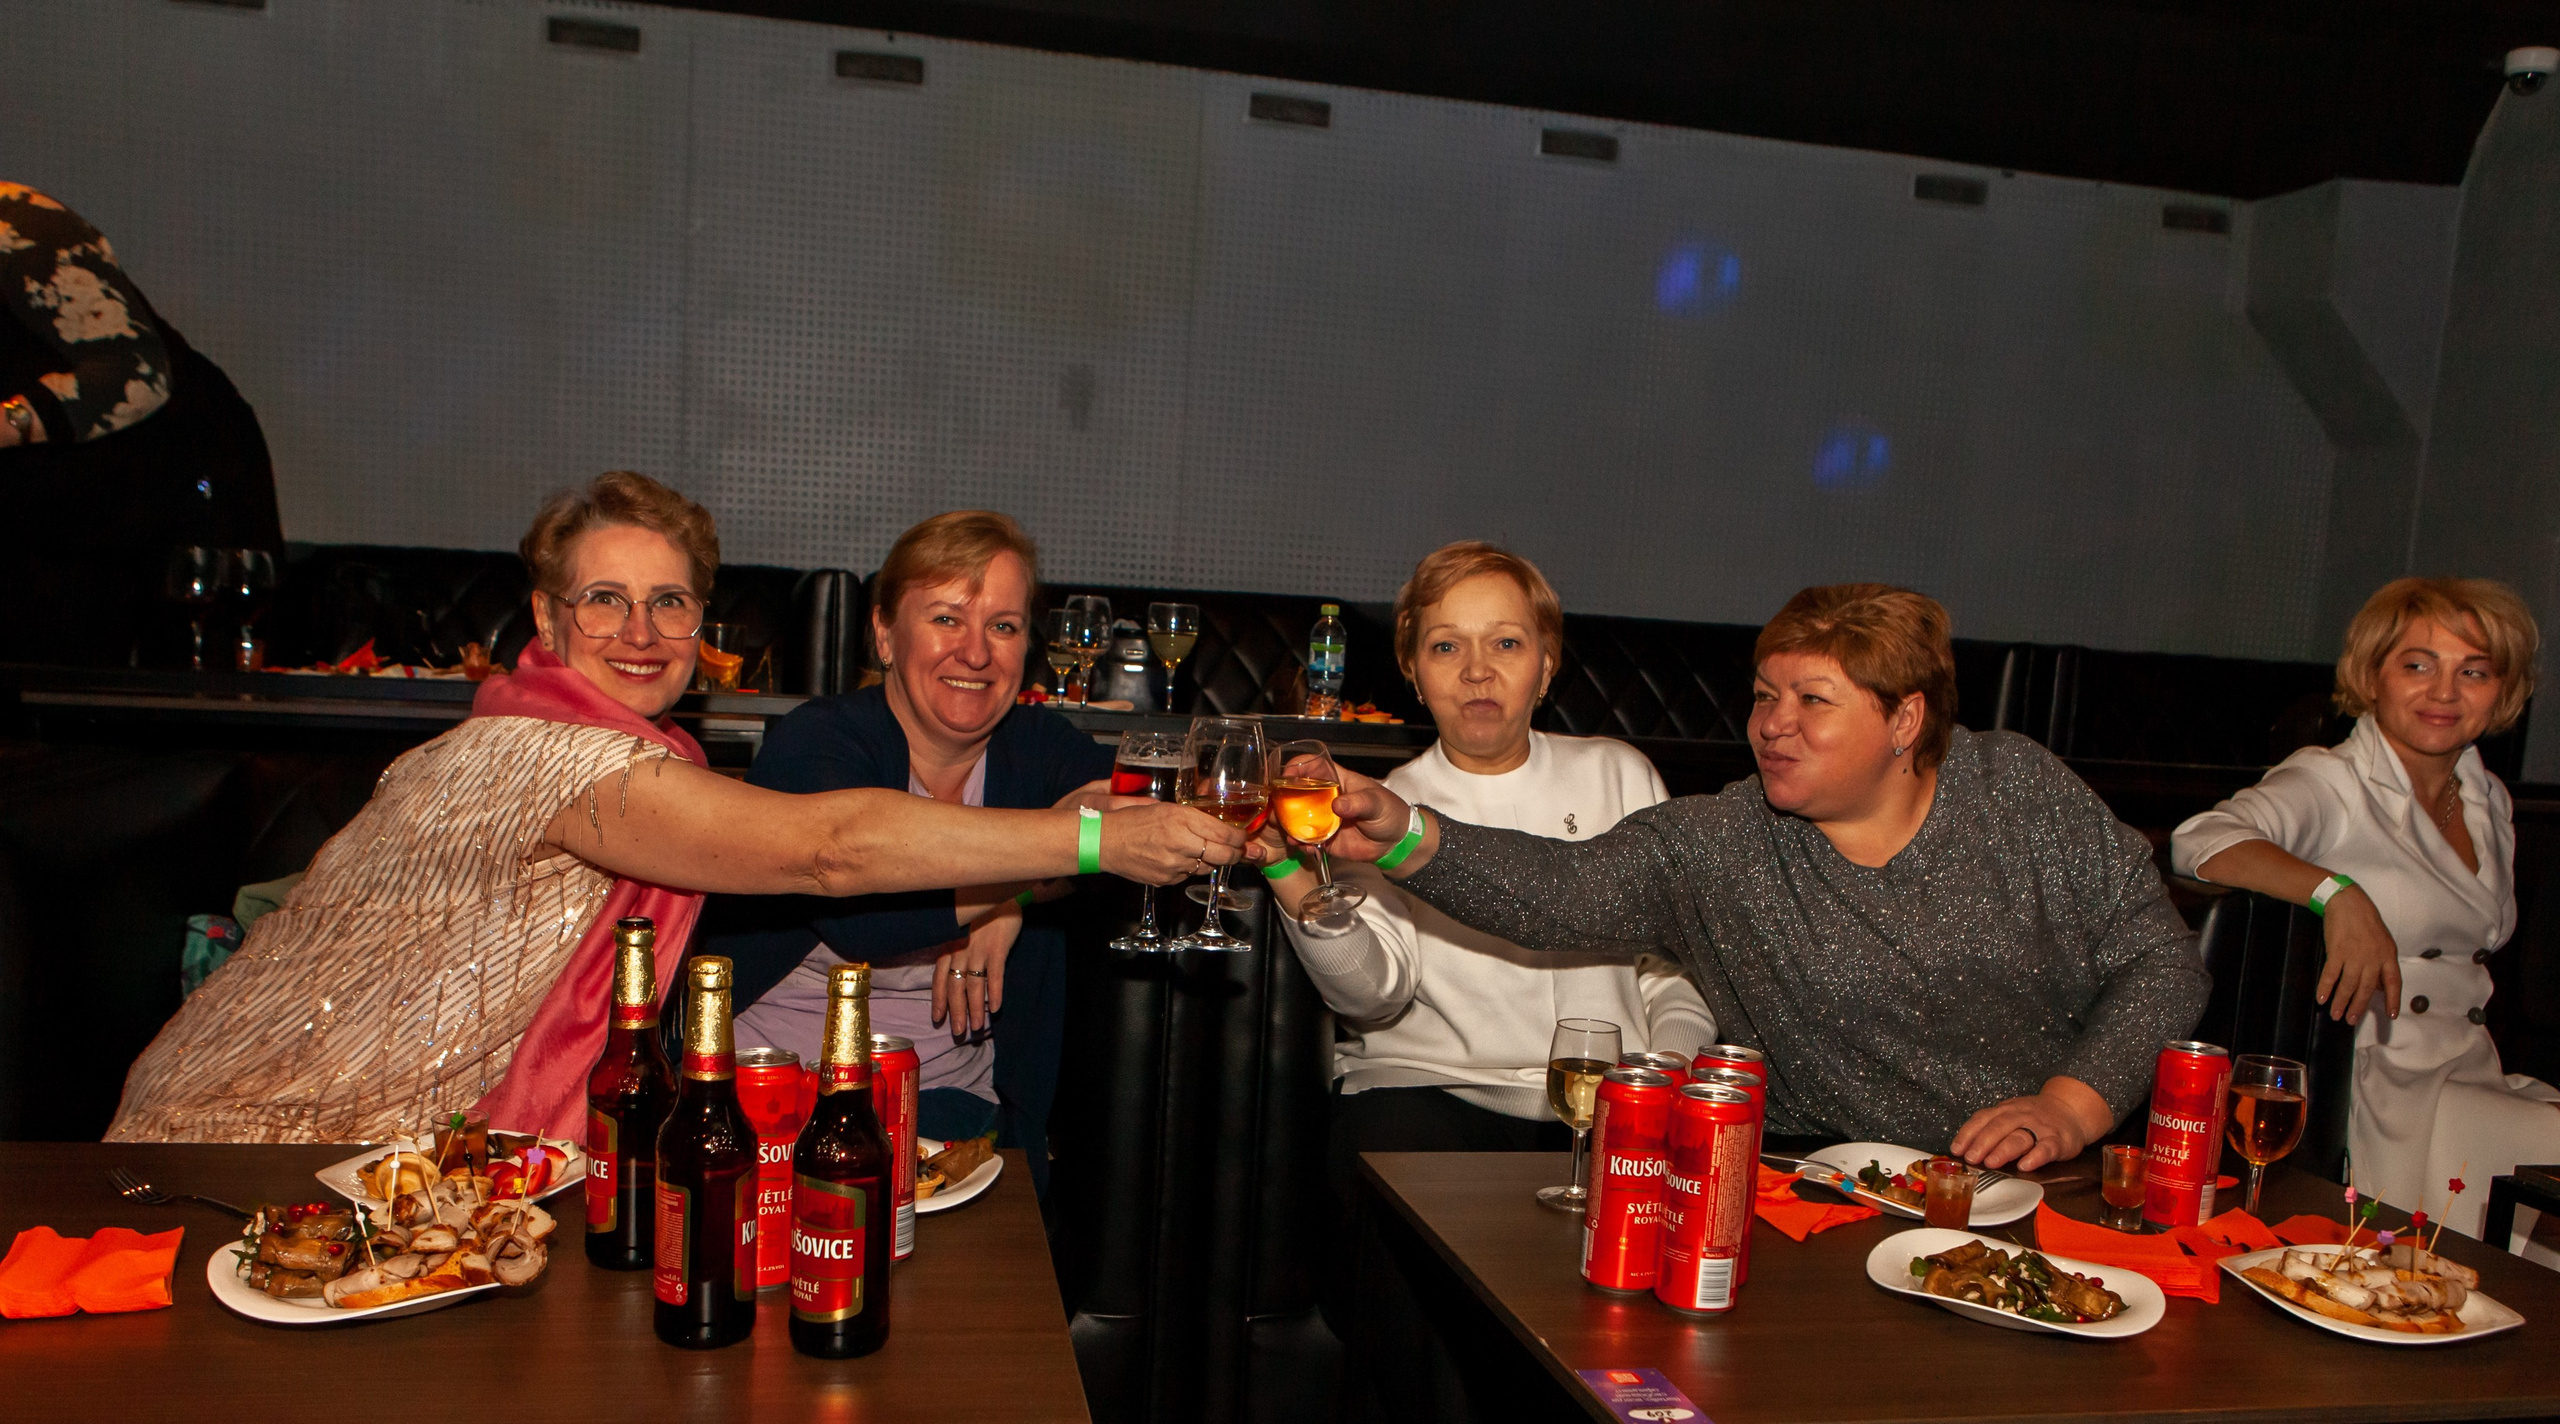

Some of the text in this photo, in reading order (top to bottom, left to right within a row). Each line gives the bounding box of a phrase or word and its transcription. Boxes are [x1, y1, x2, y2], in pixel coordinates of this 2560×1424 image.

[2150, 1109, 2207, 1134] KRUŠOVICE
[2152, 1143, 2190, 1160] SVĚTLÉ
[2156, 1154, 2182, 1167] ROYAL
